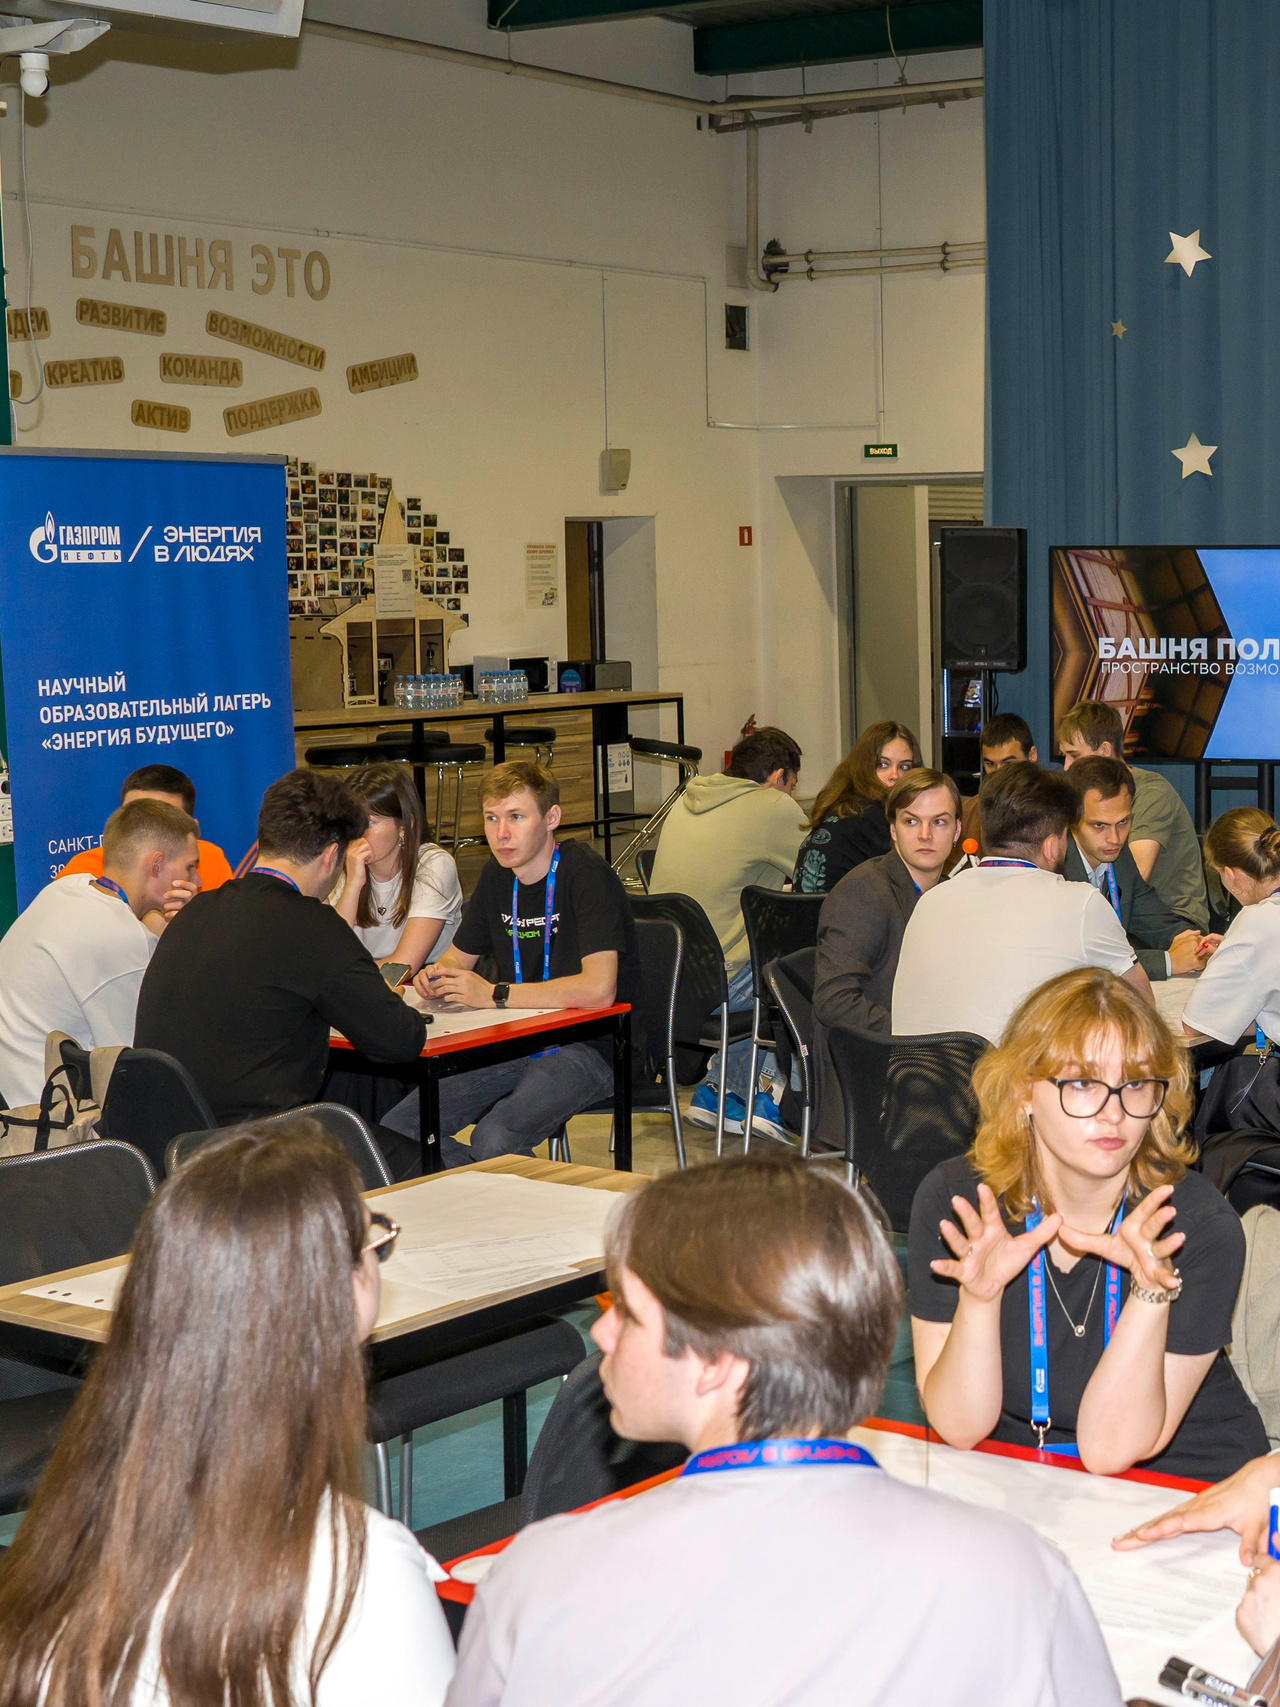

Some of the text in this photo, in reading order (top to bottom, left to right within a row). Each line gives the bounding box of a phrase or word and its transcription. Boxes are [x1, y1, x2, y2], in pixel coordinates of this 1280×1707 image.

[70, 223, 332, 300] БАШНЯ ЭТО
[77, 299, 167, 335] РАЗВИТИЕ
[207, 311, 326, 371] ВОЗМОЖНОСТИ
[46, 358, 124, 386] КРЕАТИВ
[161, 356, 241, 384] КОМАНДА
[350, 353, 418, 388] АМБИЦИИ
[133, 402, 190, 429] АКТИВ
[225, 389, 321, 433] ПОДДЕРЖКА
[58, 525, 121, 546] ГАЗПРОМ
[163, 525, 262, 543] ЭНЕРГИЯ
[63, 551, 119, 561] НЕФТЬ
[154, 545, 255, 562] В ЛЮДЯХ
[1098, 637, 1208, 660] БАШНЯ
[1101, 661, 1221, 675] ПРОСТРАНСТВО
[37, 671, 127, 697] НАУЧНЫЙ
[39, 692, 272, 724] ОБРАЗОВАТЕЛЬНЫЙ ЛАГЕРЬ
[41, 720, 235, 751] «ЭНЕРГИЯ БУДУЩЕГО»
